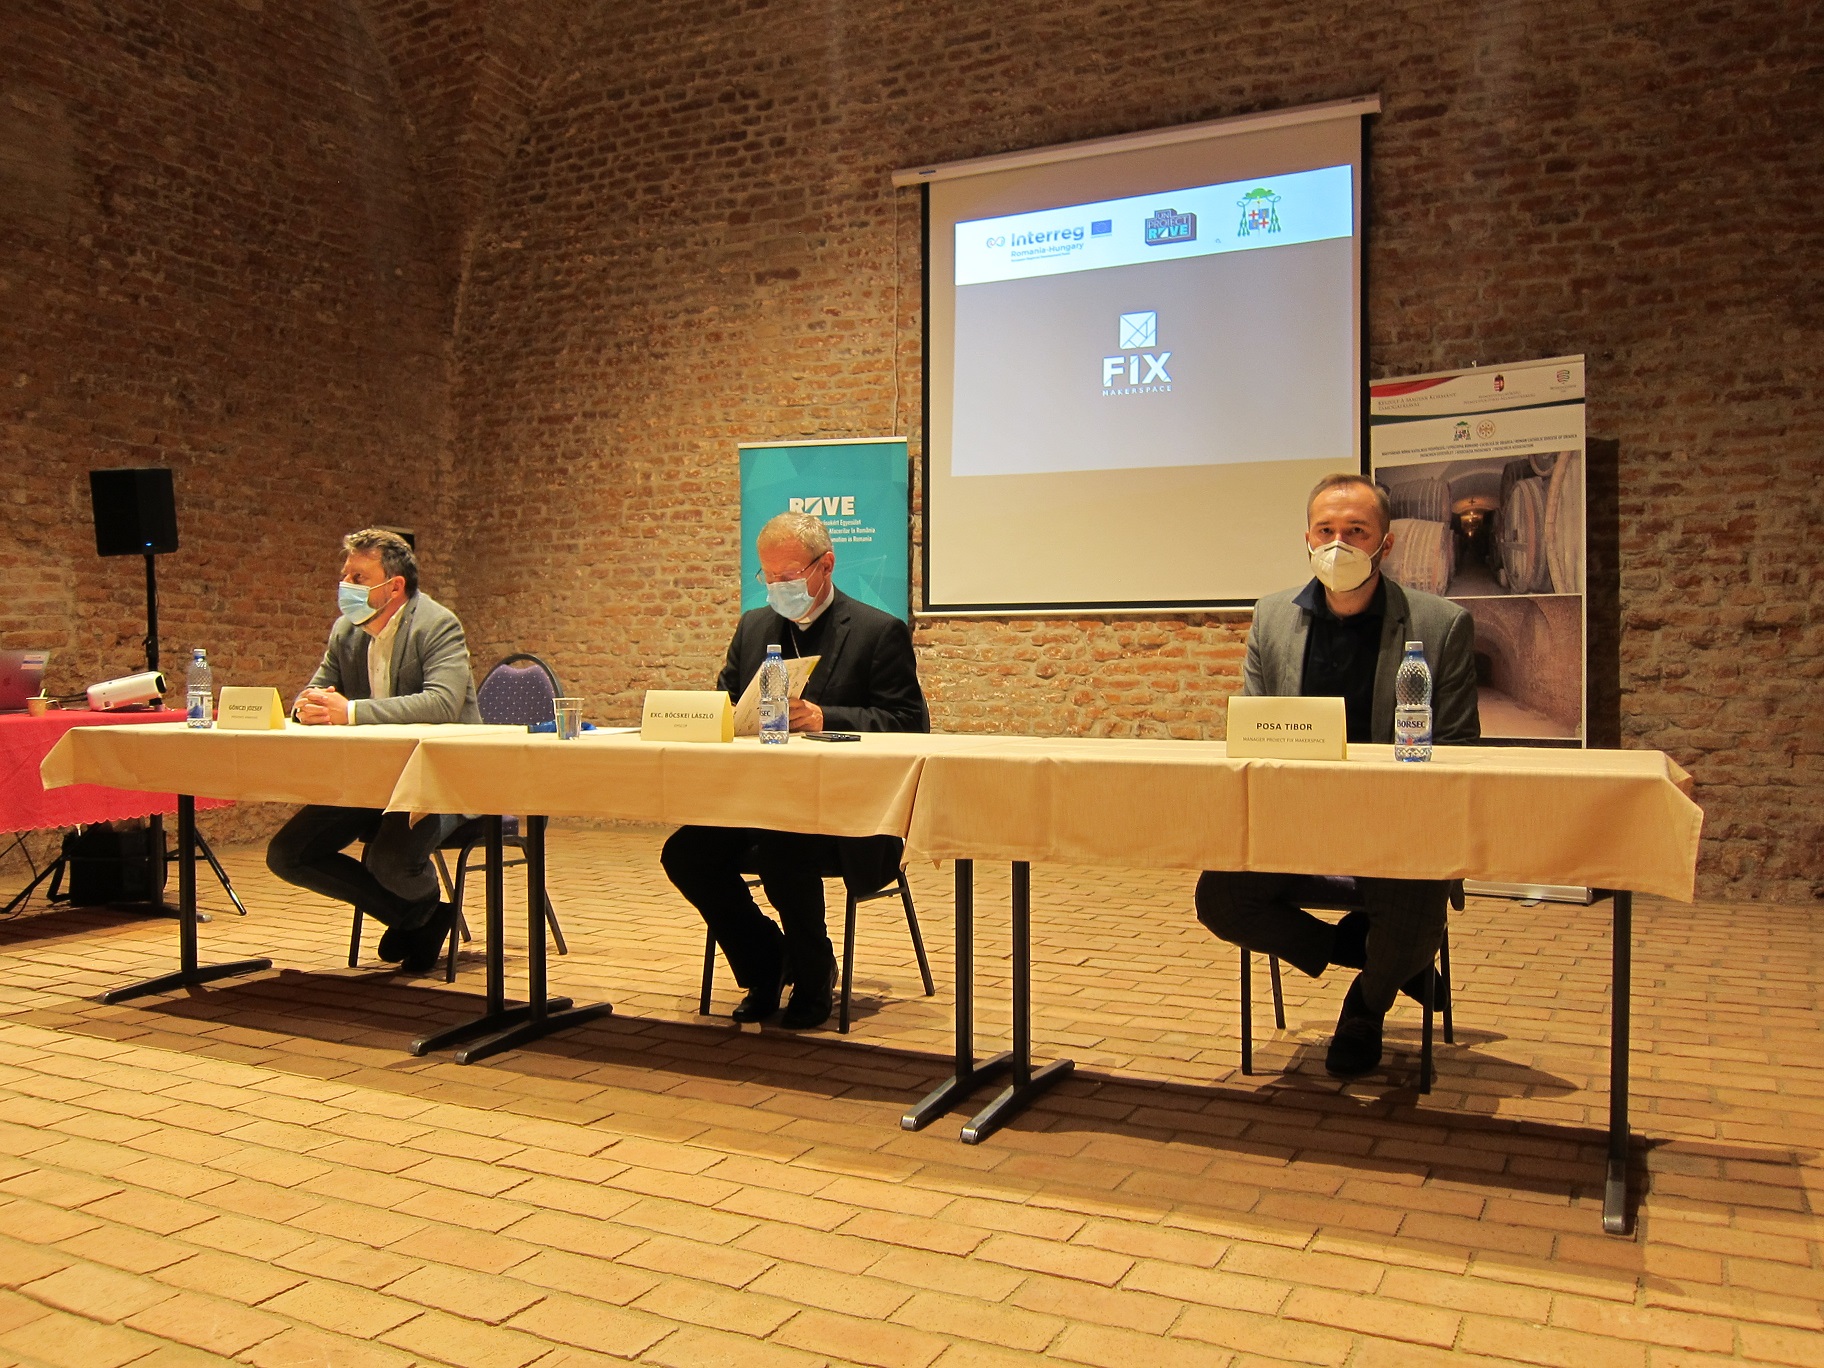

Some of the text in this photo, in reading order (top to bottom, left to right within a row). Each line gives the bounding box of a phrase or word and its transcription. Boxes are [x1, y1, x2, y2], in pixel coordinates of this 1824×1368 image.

[1011, 226, 1085, 247] Interreg
[1102, 351, 1173, 388] FIX
[1102, 385, 1173, 397] MAKERSPACE
[1256, 722, 1313, 731] POSA TIBOR
[1396, 718, 1426, 728] BORSEC
